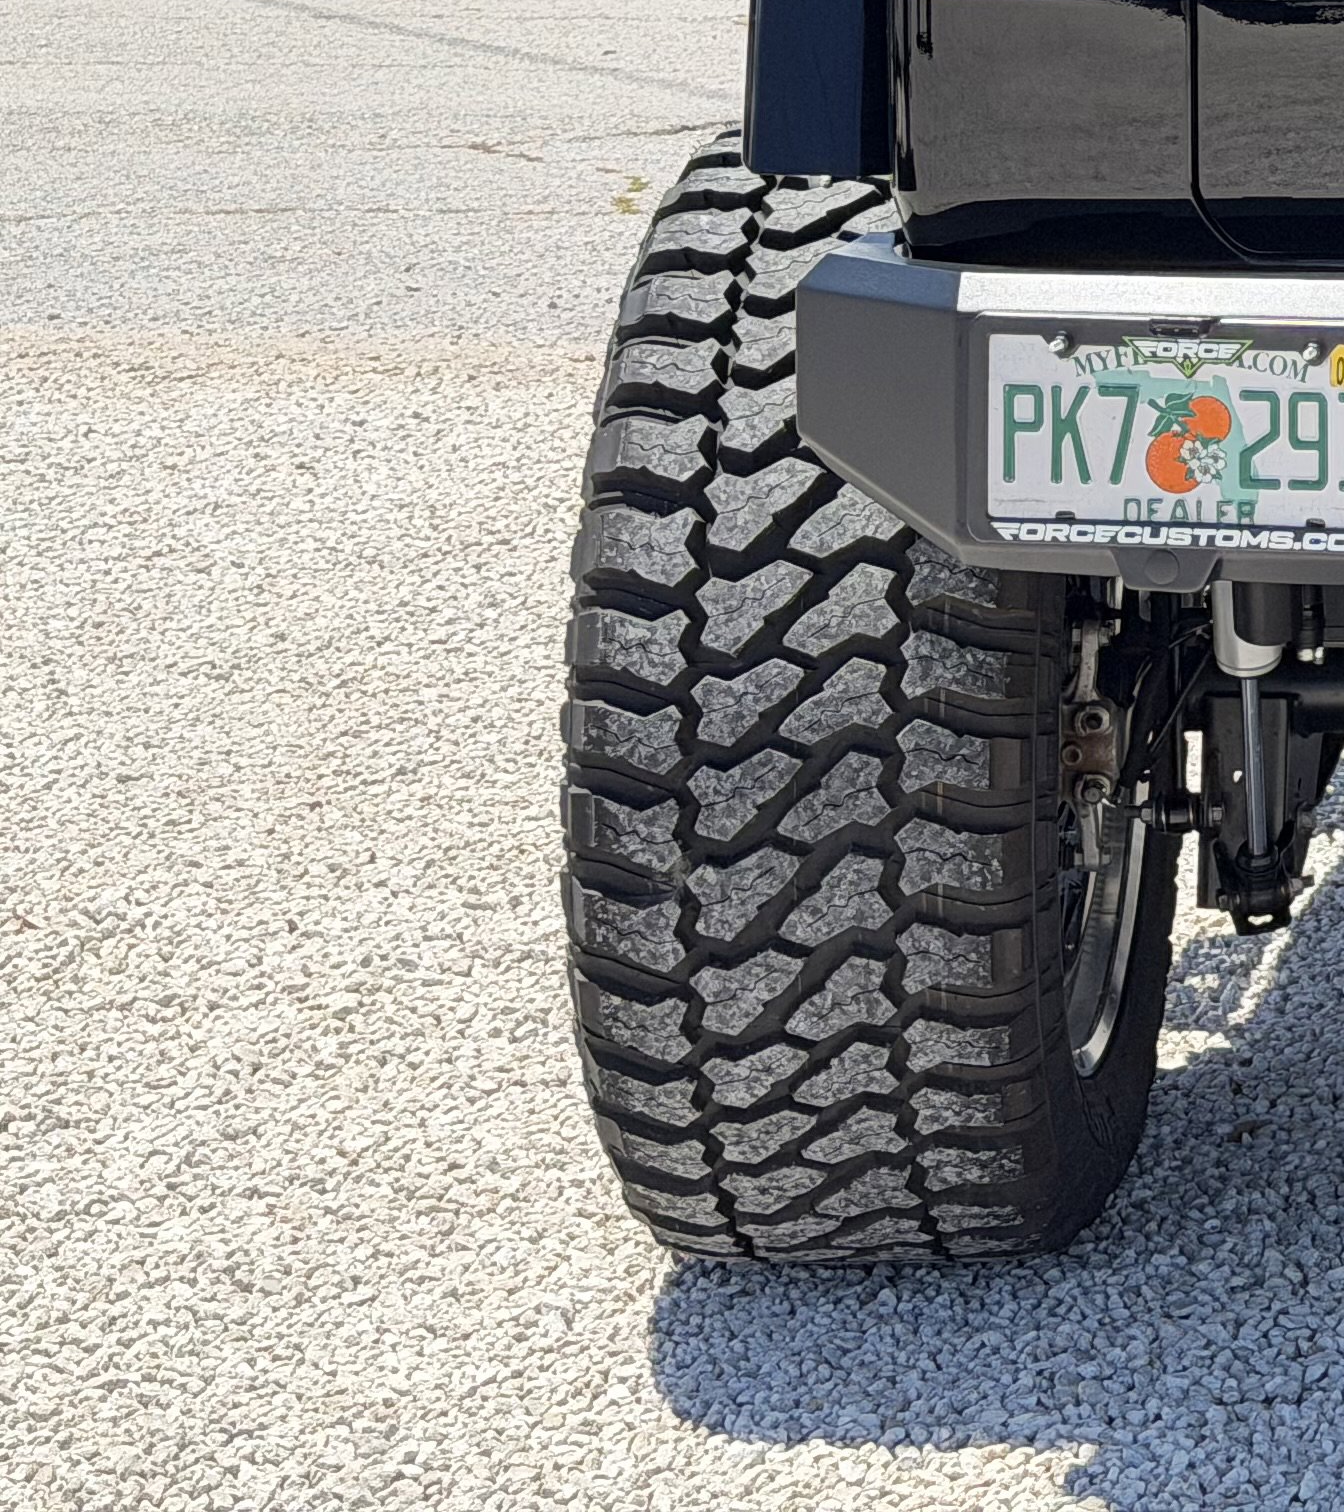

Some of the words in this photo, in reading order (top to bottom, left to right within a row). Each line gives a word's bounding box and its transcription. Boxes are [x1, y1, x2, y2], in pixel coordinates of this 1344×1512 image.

[1130, 338, 1240, 366] FORCE
[1003, 383, 1140, 485] PK7
[1123, 498, 1257, 526] DEALER
